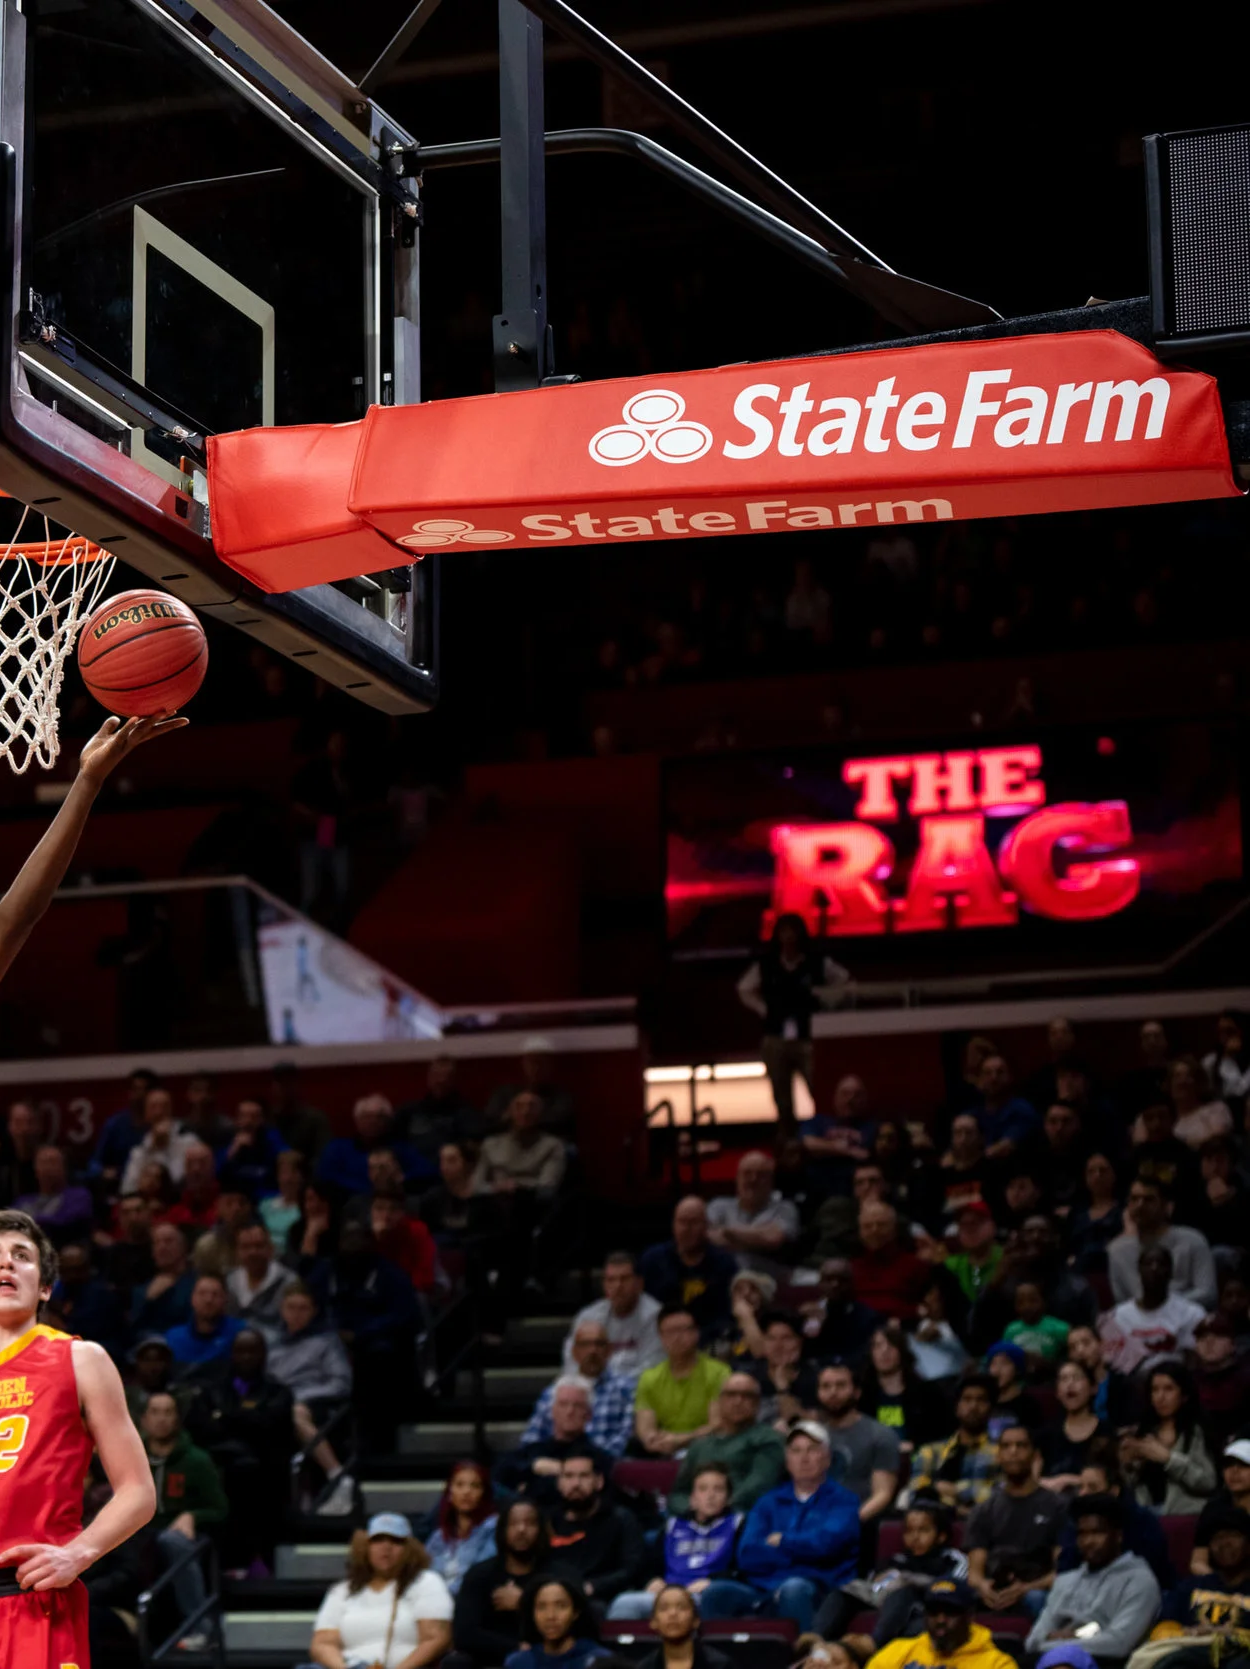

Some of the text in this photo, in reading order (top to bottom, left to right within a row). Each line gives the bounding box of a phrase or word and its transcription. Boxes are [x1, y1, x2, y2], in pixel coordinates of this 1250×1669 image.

[722, 369, 1171, 461] State Farm
[521, 498, 954, 541] State Farm
[92, 602, 179, 640] Wilson
[842, 744, 1046, 821] THE
